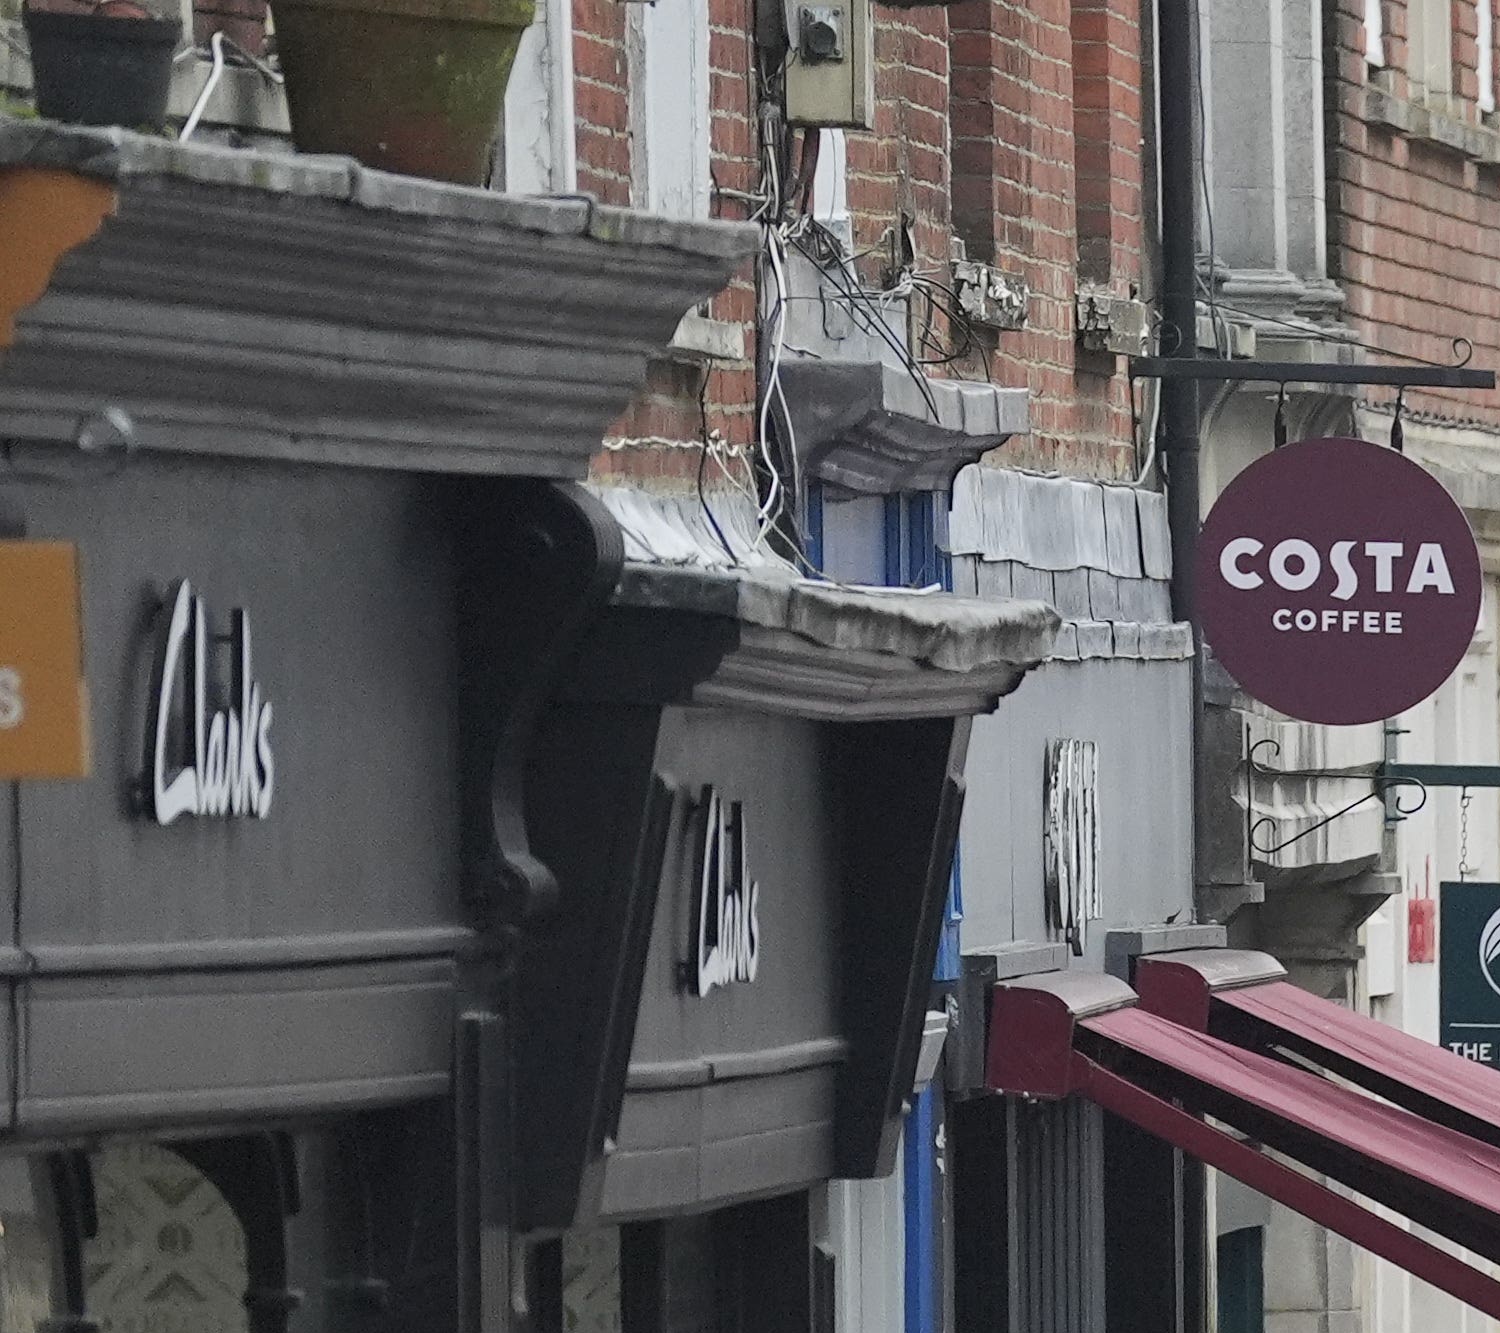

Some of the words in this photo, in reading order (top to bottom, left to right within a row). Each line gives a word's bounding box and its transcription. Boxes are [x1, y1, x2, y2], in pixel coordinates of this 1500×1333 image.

[1219, 537, 1455, 600] COSTA
[1272, 608, 1403, 634] COFFEE
[1449, 1043, 1492, 1061] THE
